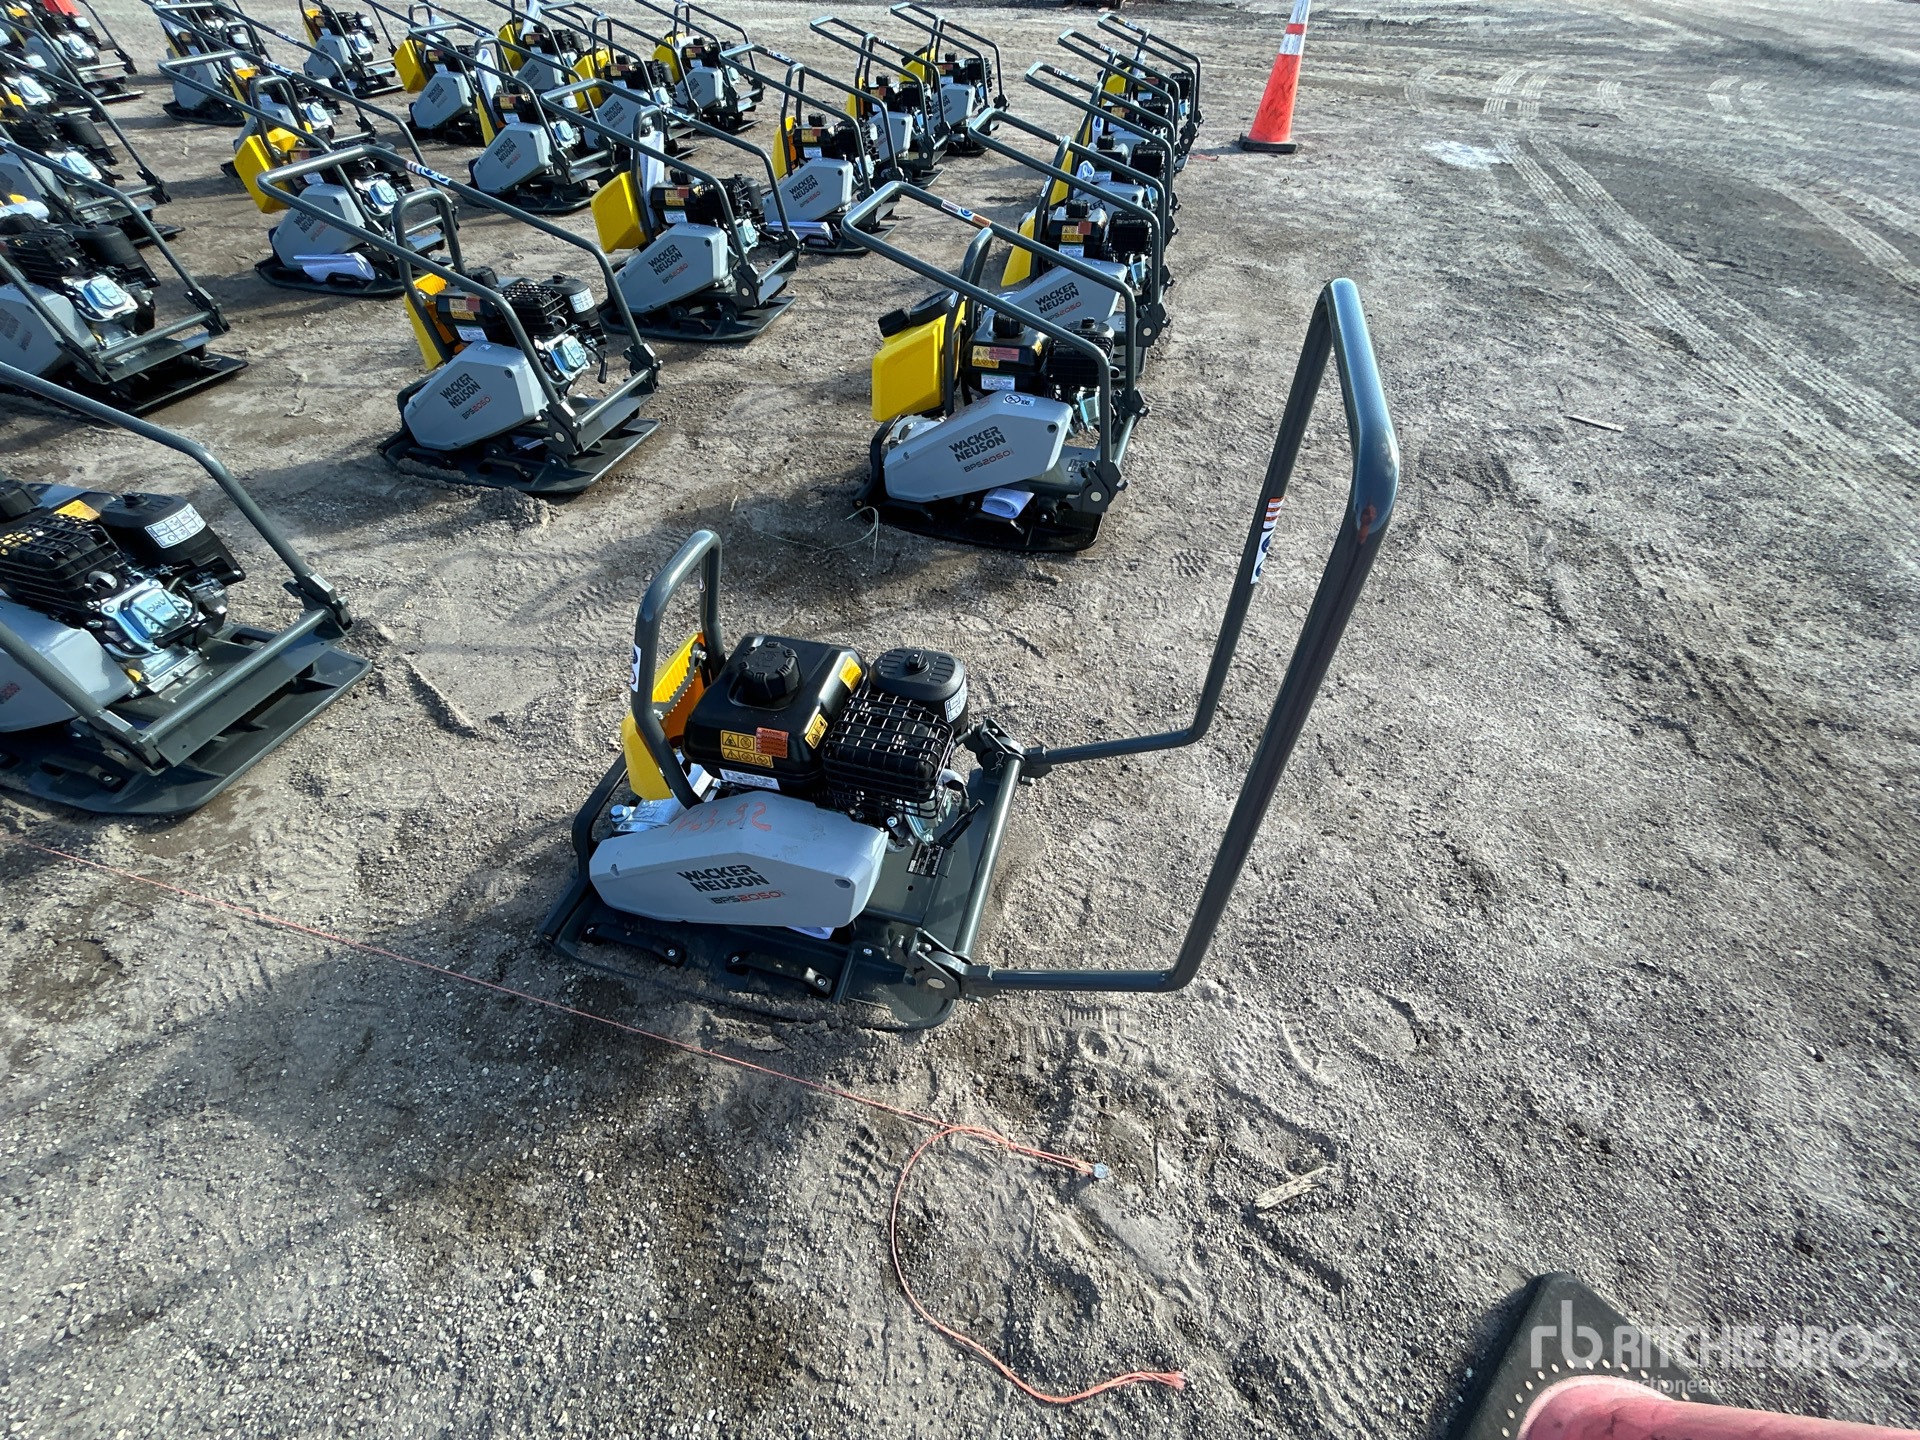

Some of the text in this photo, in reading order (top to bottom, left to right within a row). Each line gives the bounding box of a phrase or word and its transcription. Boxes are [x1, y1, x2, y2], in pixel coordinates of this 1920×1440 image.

[789, 174, 815, 195] WACKER
[792, 179, 819, 201] NEUSON
[648, 244, 678, 268] WACKER
[653, 250, 683, 276] NEUSON
[1035, 281, 1077, 306] WACKER
[1038, 288, 1080, 314] NEUSON
[440, 373, 474, 400] WACKER
[448, 381, 482, 409] NEUSON
[948, 425, 1001, 453] WACKER
[954, 434, 1007, 463] NEUSON
[676, 864, 758, 882] WACKER
[689, 874, 770, 892] NEUSON
